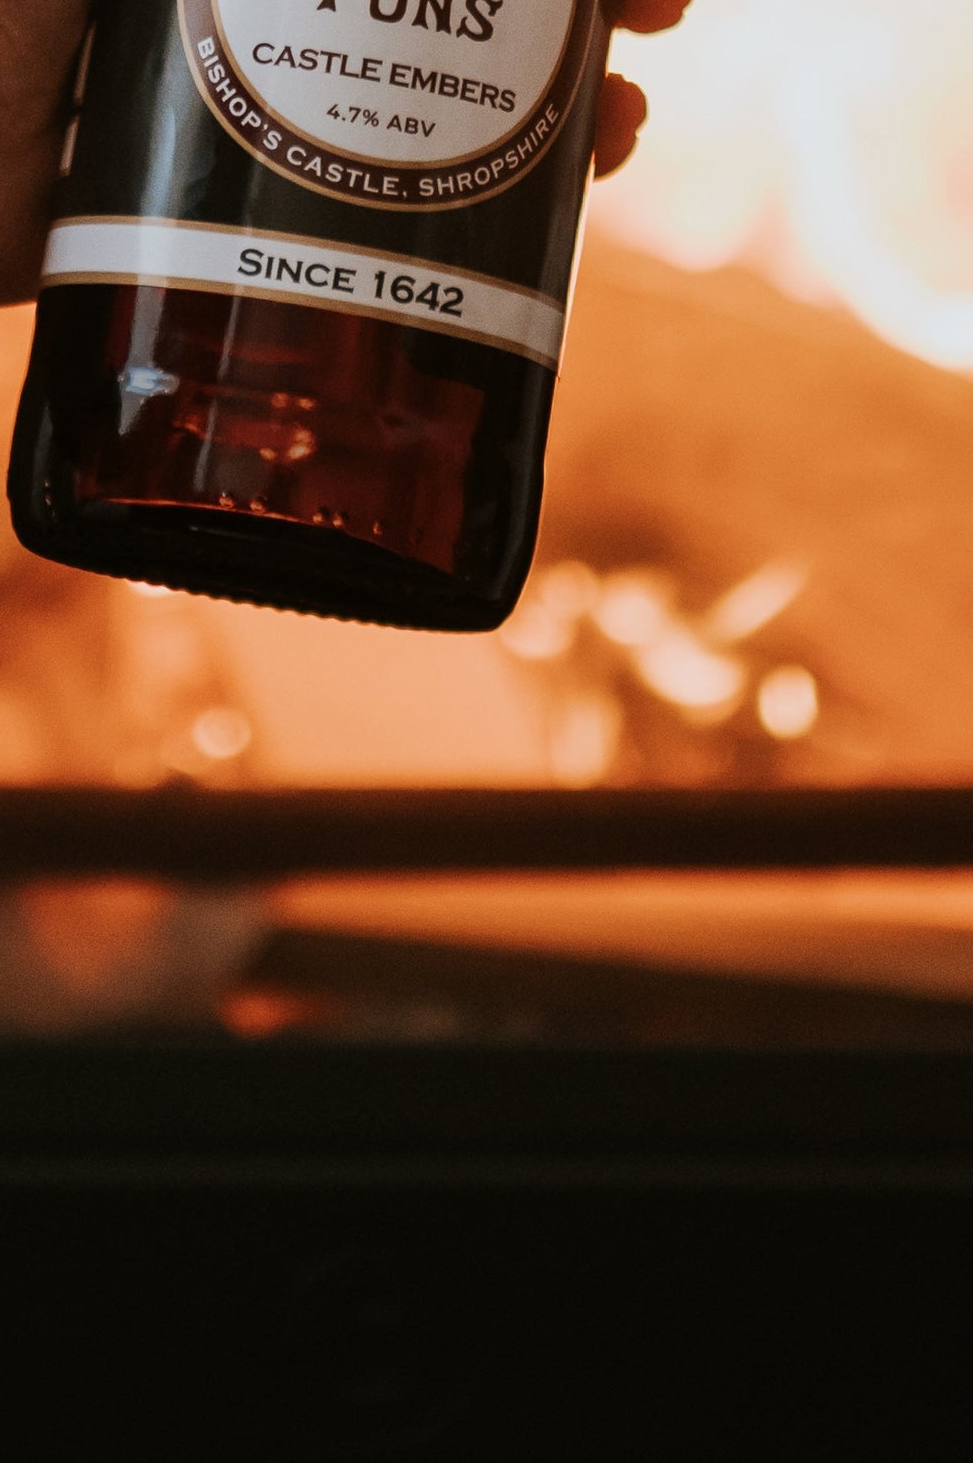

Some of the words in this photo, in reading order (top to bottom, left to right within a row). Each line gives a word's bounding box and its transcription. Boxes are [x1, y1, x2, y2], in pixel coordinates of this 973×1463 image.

[252, 43, 383, 82] CASTLE
[389, 62, 517, 113] EMBERS
[196, 37, 283, 150] BISHOP'S
[286, 145, 408, 198] CASTLE,
[418, 103, 559, 197] SHROPSHIRE
[326, 104, 380, 128] 4.7%
[387, 114, 436, 138] ABV
[237, 248, 357, 294] SINCE
[372, 270, 465, 318] 1642
